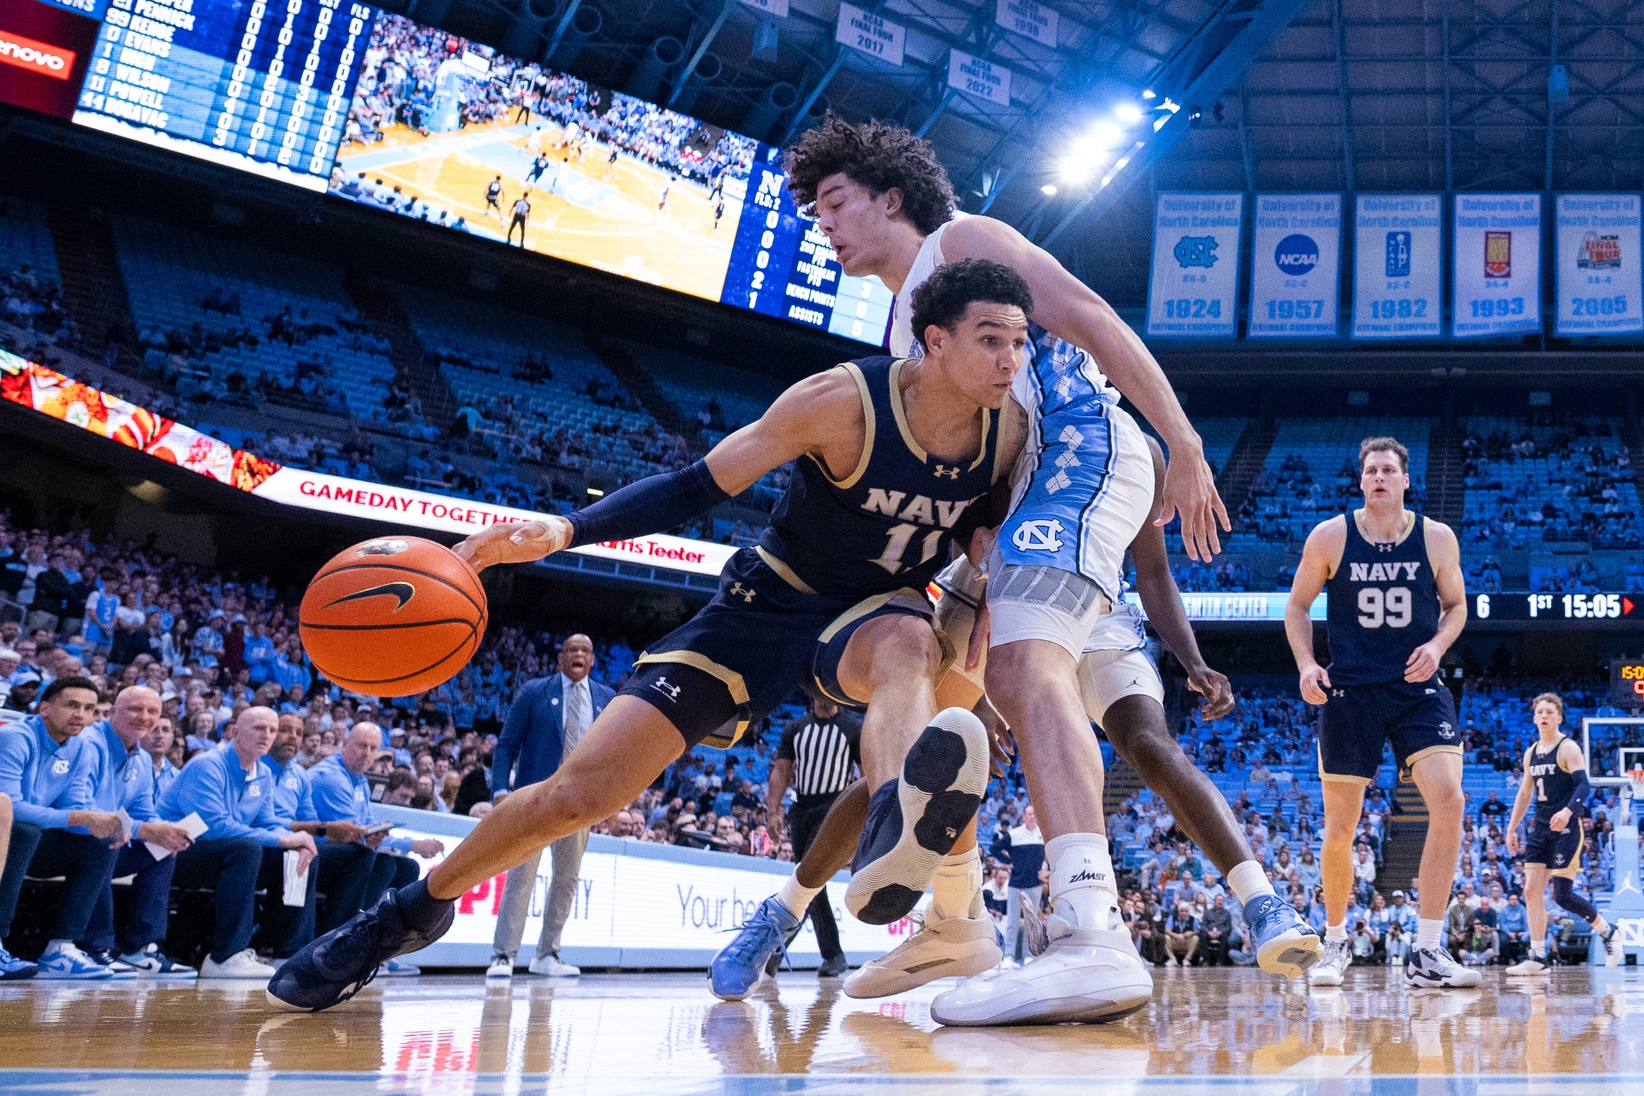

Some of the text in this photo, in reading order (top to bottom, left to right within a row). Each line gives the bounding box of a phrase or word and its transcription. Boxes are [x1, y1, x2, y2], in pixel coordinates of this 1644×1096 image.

[106, 8, 131, 27] 99
[351, 3, 370, 20] FLS
[103, 42, 112, 58] 1
[124, 30, 172, 58] EVANS
[858, 34, 884, 54] 2017
[96, 58, 110, 74] 8
[116, 64, 171, 93] WILSON
[90, 75, 106, 92] 11
[109, 80, 163, 110] POWELL
[966, 78, 992, 96] 2022
[82, 92, 105, 110] 44
[758, 170, 784, 197] N
[766, 210, 778, 228] 0
[761, 230, 774, 248] 0
[756, 250, 770, 268] 0
[1278, 253, 1318, 266] NCAA
[751, 271, 764, 290] 2
[748, 292, 758, 309] 1
[810, 289, 836, 308] POINTS
[1164, 298, 1221, 318] 1924
[1370, 298, 1427, 318] 1982
[1470, 297, 1524, 318] 1993
[1572, 295, 1628, 316] 2005
[788, 304, 824, 326] ASSISTS
[1266, 299, 1324, 320] 1957
[300, 480, 531, 526] GAMEDAY TOGETH
[861, 488, 980, 528] NAV
[647, 541, 705, 563] Teeter
[1350, 562, 1420, 582] NAVY
[1184, 596, 1268, 618] SMITH CENTER
[1358, 587, 1412, 628] 99
[1476, 594, 1620, 618] 6 1ST 15:05
[1622, 666, 1644, 680] 15:0
[1536, 778, 1548, 802] 1
[677, 884, 727, 928] Your
